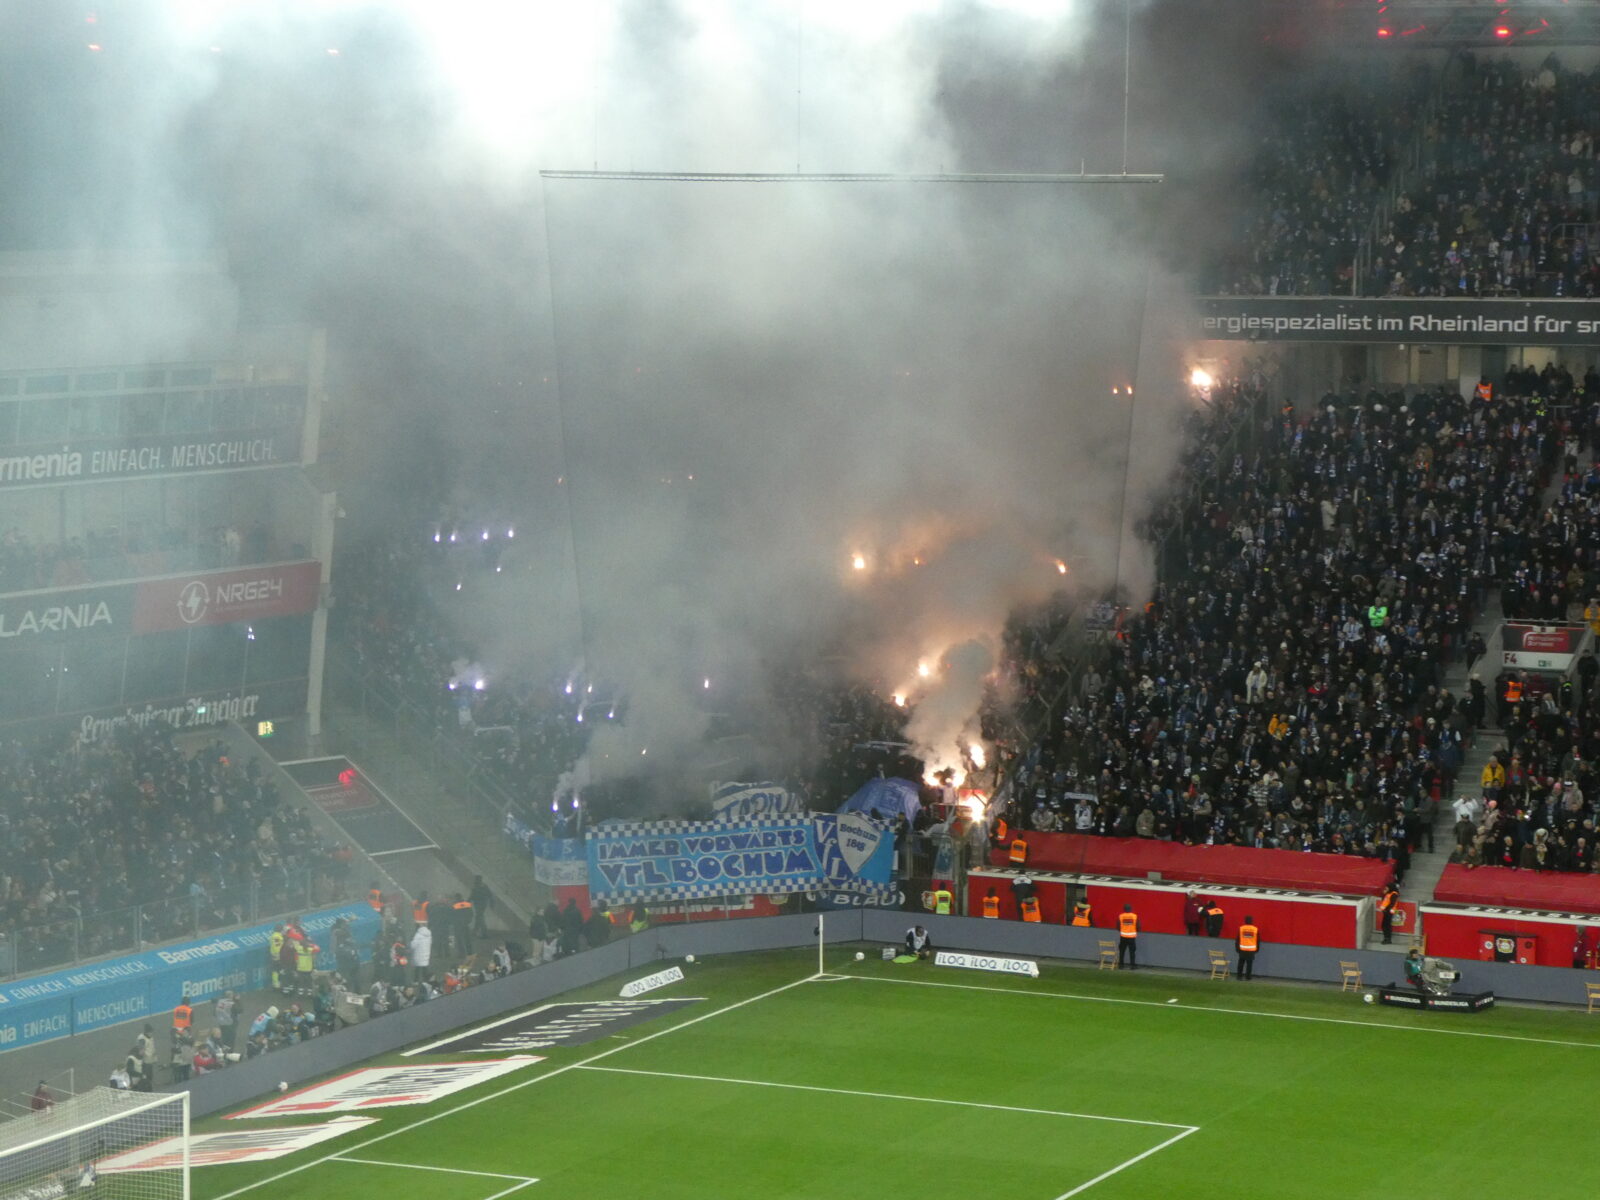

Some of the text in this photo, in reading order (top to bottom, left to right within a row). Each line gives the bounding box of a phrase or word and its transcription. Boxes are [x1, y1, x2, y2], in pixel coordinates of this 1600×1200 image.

[1377, 315, 1403, 331] im
[1409, 315, 1528, 332] Rheinland
[1533, 315, 1571, 333] für
[91, 447, 165, 474] EINFACH.
[171, 439, 278, 468] MENSCHLICH.
[215, 578, 283, 604] NRG24
[1503, 653, 1518, 665] F4
[598, 839, 681, 861] IMMER
[683, 828, 807, 854] VORWÄRTS
[840, 823, 879, 842] Bochum
[670, 847, 818, 884] BOCHUM
[10, 980, 72, 1000] EINFACH.
[67, 960, 153, 987] MENSCHLICH.
[158, 938, 240, 965] Barmenia
[23, 1014, 70, 1039] EINFACH.
[77, 996, 148, 1026] MENSCHLICH.
[180, 966, 248, 998] Barmenia
